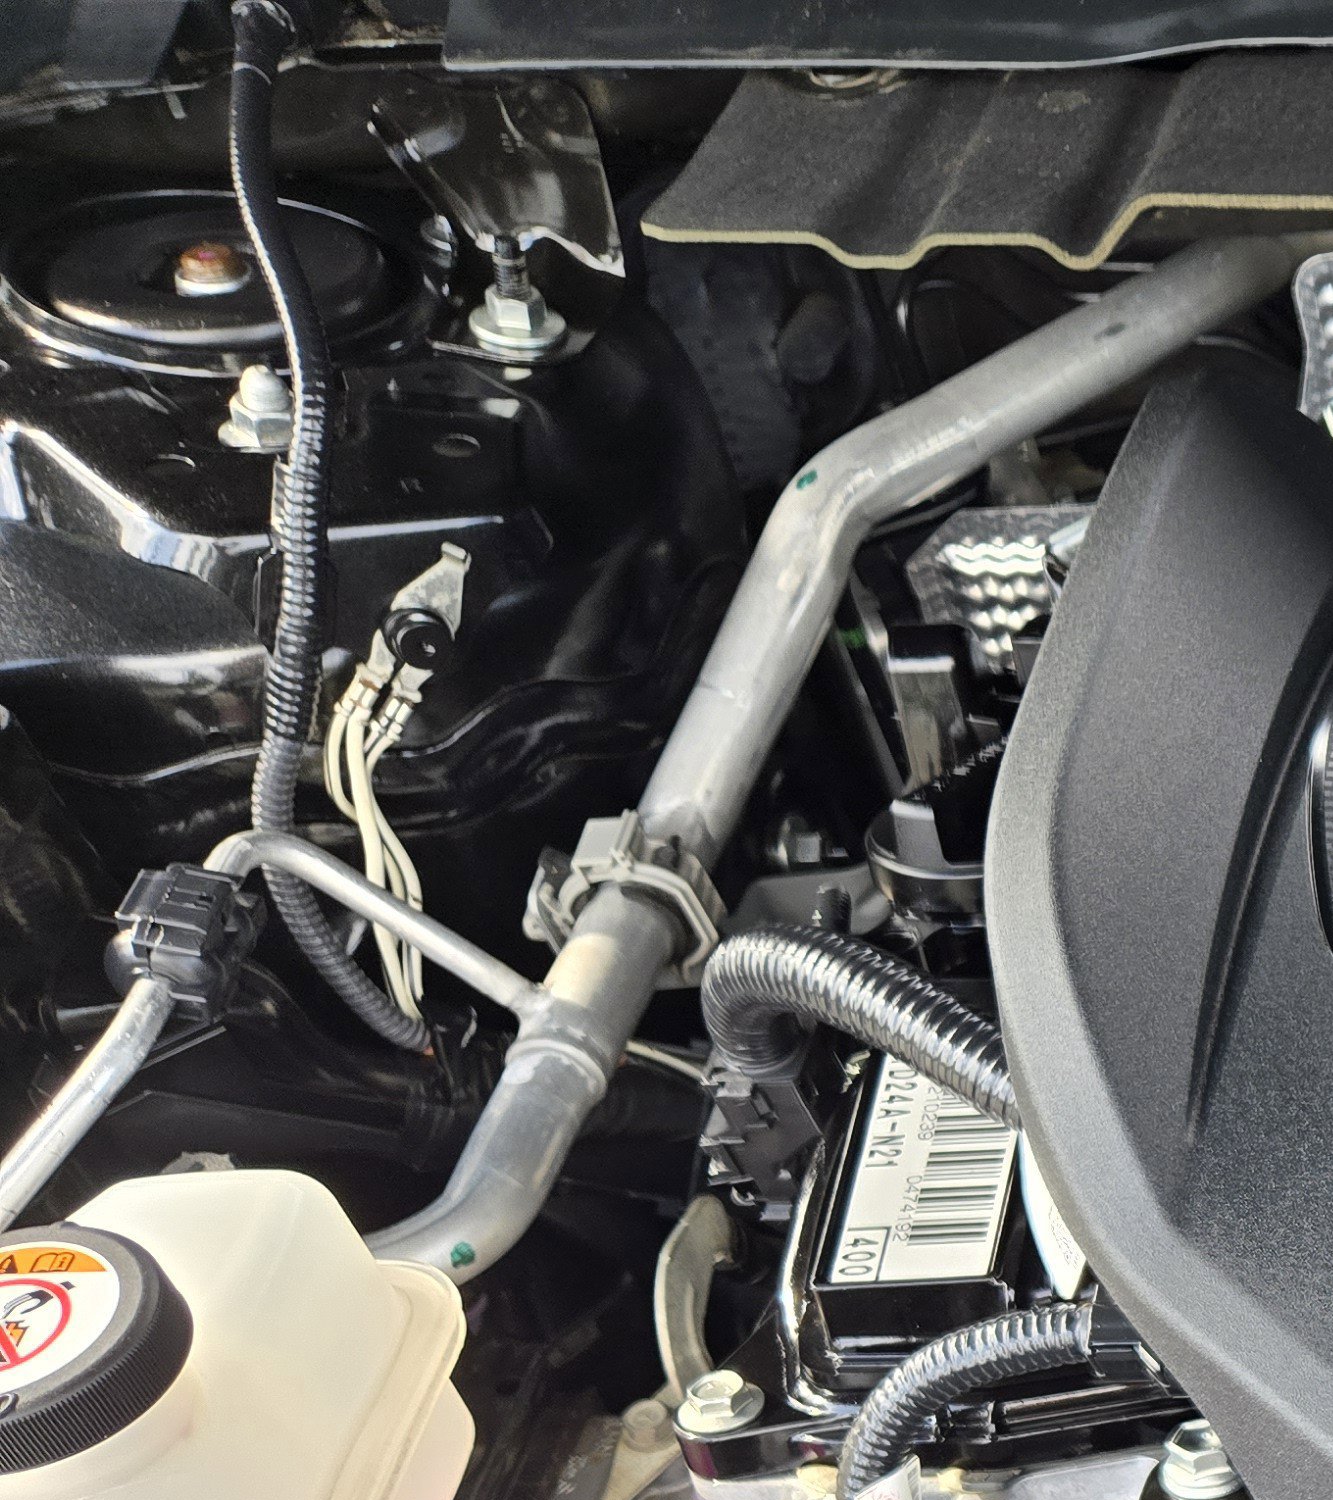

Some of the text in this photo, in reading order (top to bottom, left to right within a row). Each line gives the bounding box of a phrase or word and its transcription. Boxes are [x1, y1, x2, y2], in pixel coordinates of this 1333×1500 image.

[865, 1060, 918, 1168] D24A-N21
[893, 1176, 922, 1242] 0474192
[839, 1238, 879, 1276] 400
